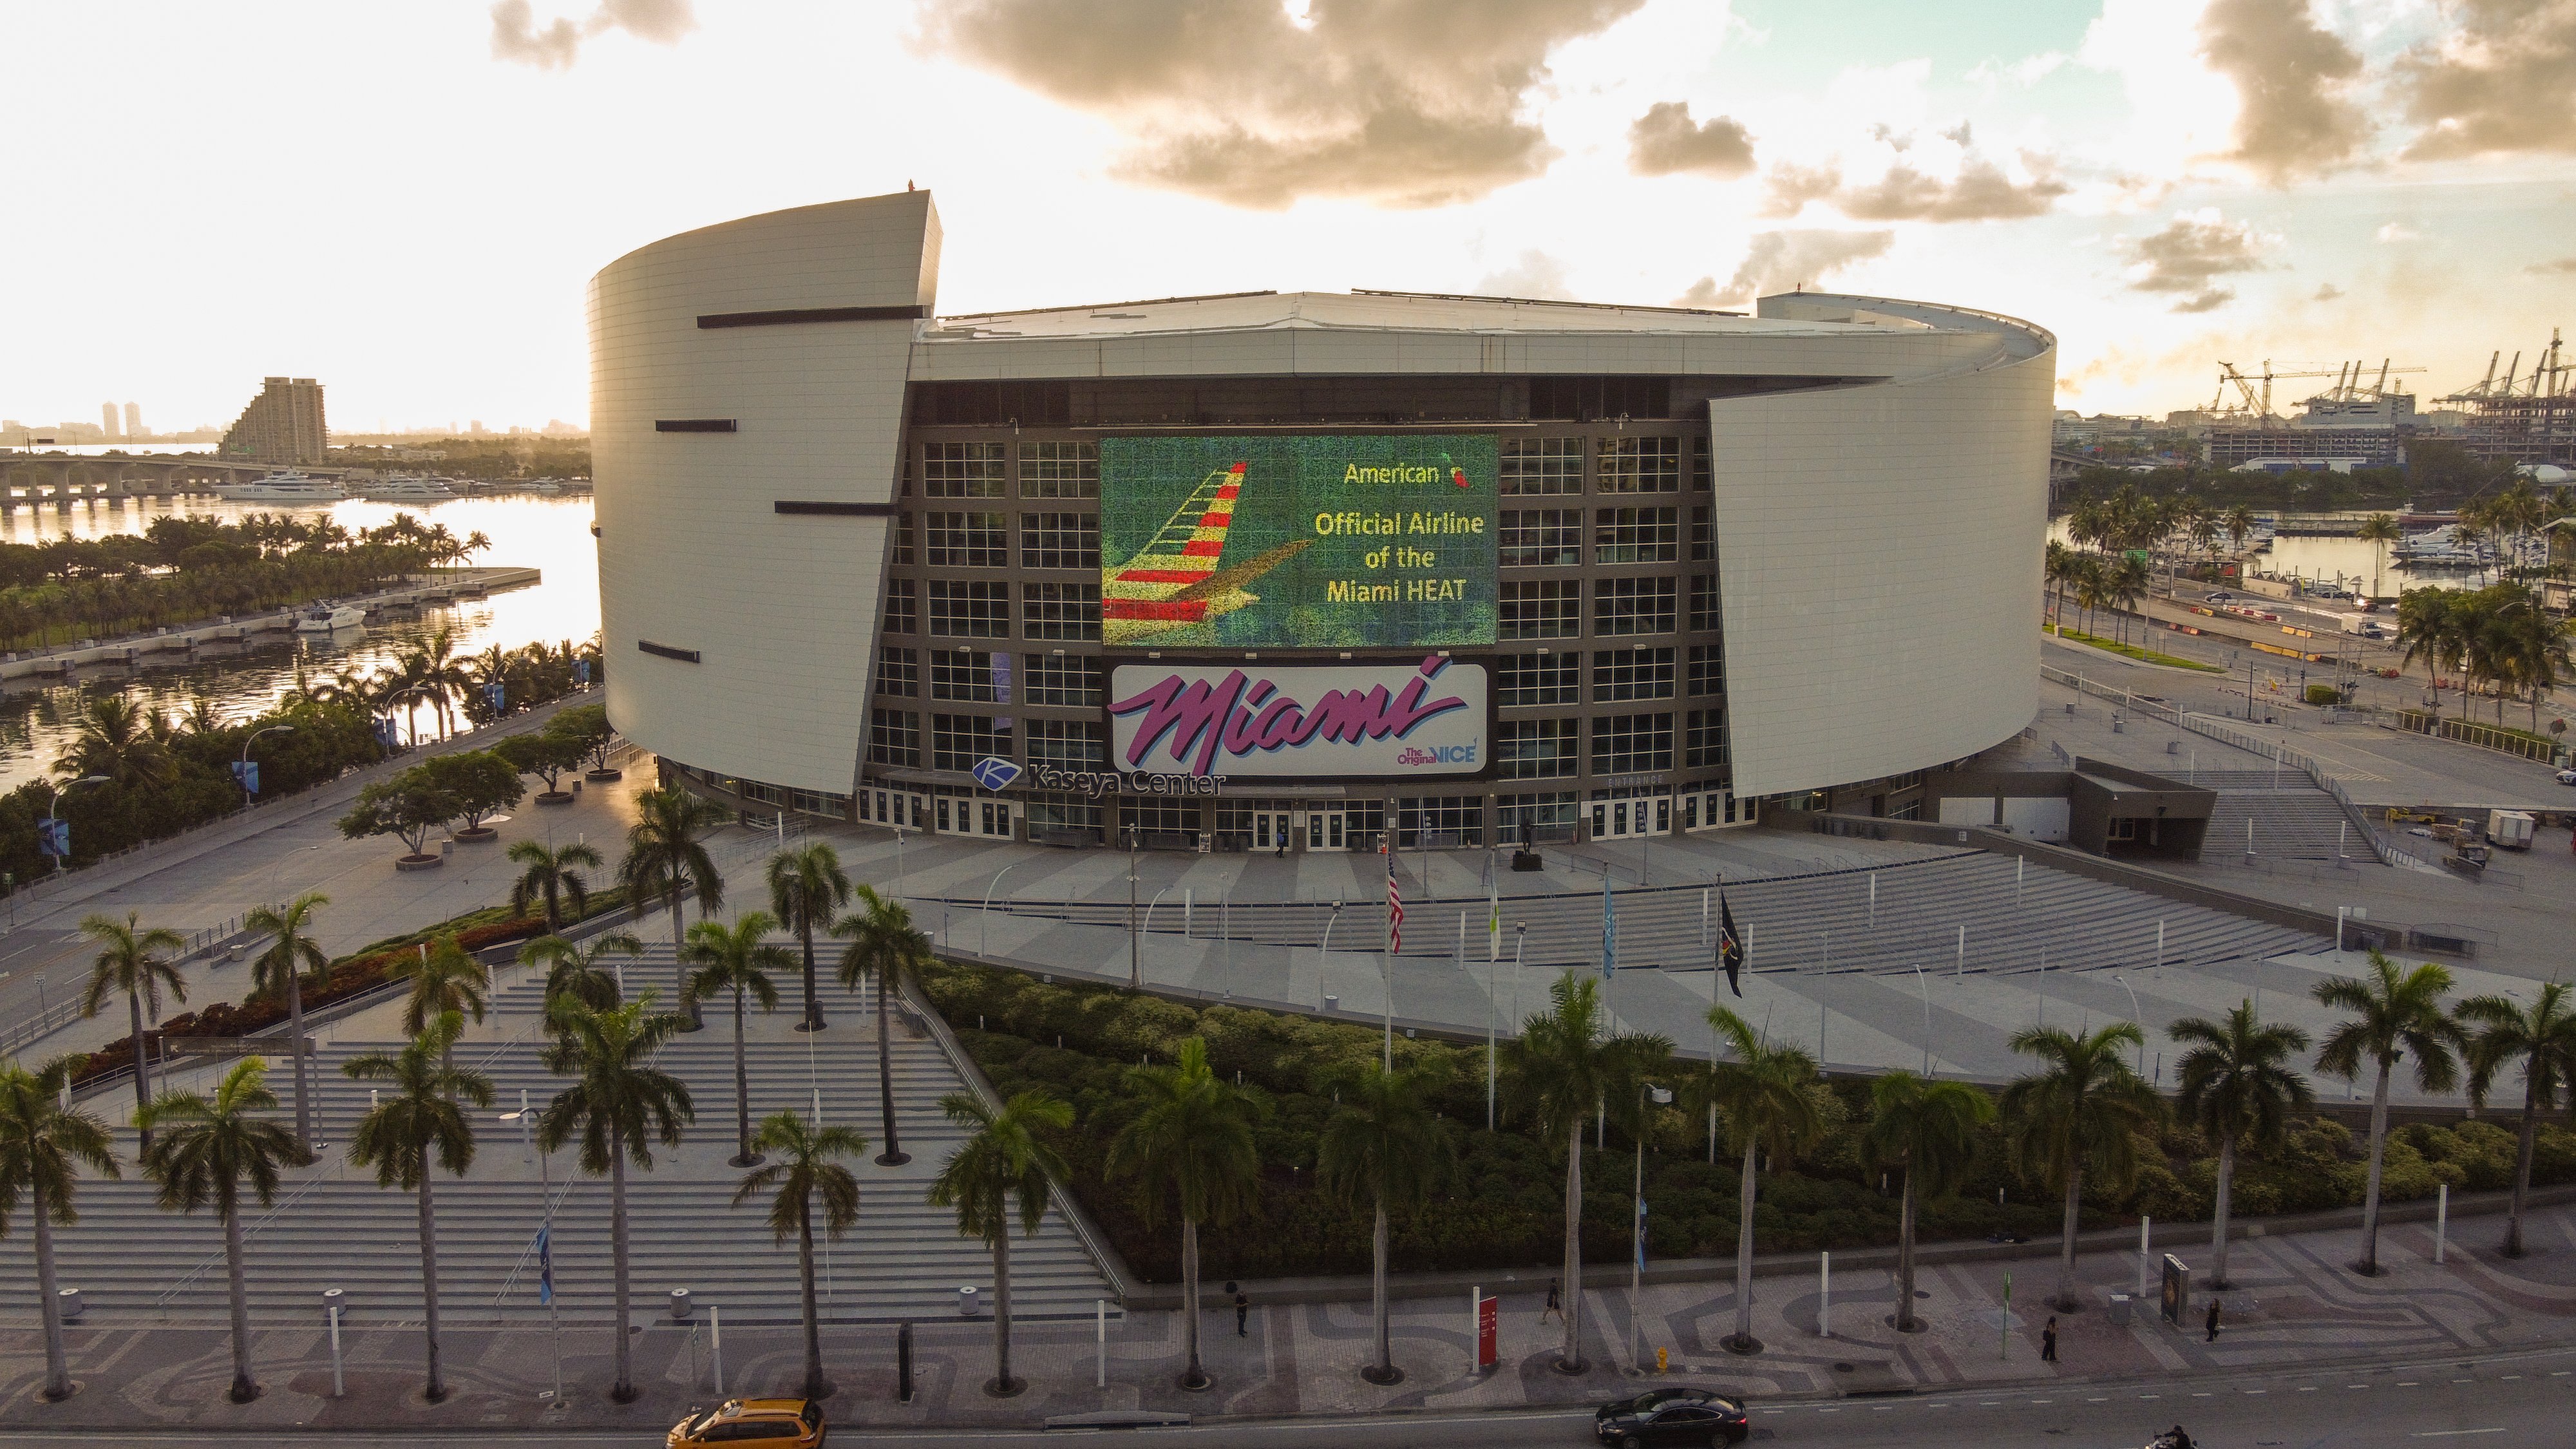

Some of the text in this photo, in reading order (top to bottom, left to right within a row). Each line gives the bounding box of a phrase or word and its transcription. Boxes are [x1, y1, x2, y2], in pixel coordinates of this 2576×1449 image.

[1344, 462, 1439, 484] American
[1315, 512, 1484, 535] Official Airline
[1365, 545, 1435, 569] of the
[1327, 579, 1466, 603] Miami HEAT
[1107, 656, 1468, 777] Miami
[1397, 753, 1437, 766] Original
[1405, 747, 1423, 757] The
[1029, 764, 1121, 799] Kaseya
[1129, 770, 1227, 795] Center
[1607, 774, 1663, 788] ENTRANCE
